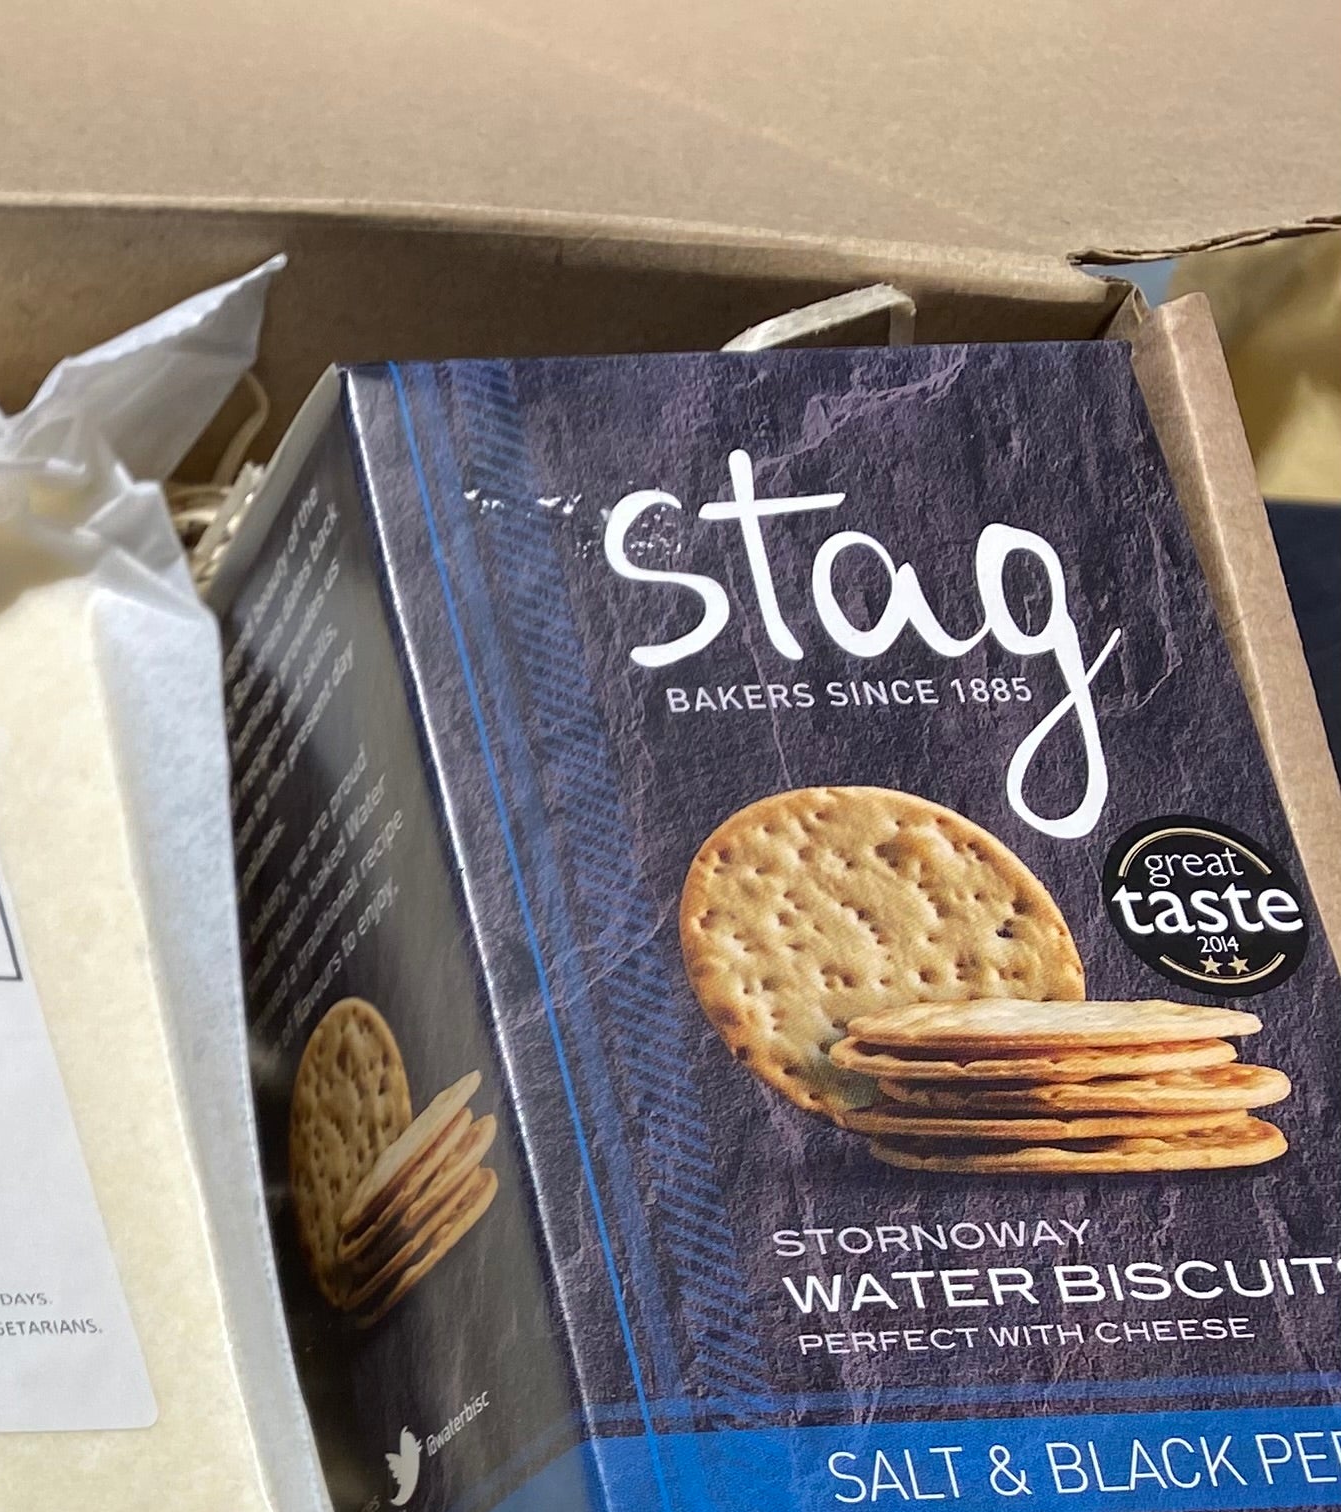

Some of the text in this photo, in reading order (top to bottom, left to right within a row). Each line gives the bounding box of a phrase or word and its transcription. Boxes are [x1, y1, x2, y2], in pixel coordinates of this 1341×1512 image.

[604, 449, 1121, 840] stag
[665, 676, 1033, 714] BAKERS SINCE 1885
[327, 740, 370, 821] proud
[306, 772, 388, 900] baked Water
[358, 805, 405, 879] recipe
[1144, 847, 1244, 887] great
[1111, 883, 1303, 935] taste
[1197, 935, 1239, 953] 2014
[771, 1218, 1092, 1258] STORNOWAY
[0, 1292, 53, 1306] DAYS.
[782, 1256, 1341, 1314] WATER BISCUIT
[797, 1316, 1255, 1356] PERFECT WITH CHEESE
[426, 1391, 490, 1457] @waterbisc
[827, 1445, 962, 1503] SALT
[988, 1445, 1033, 1498] &
[1045, 1435, 1248, 1495] BLACK
